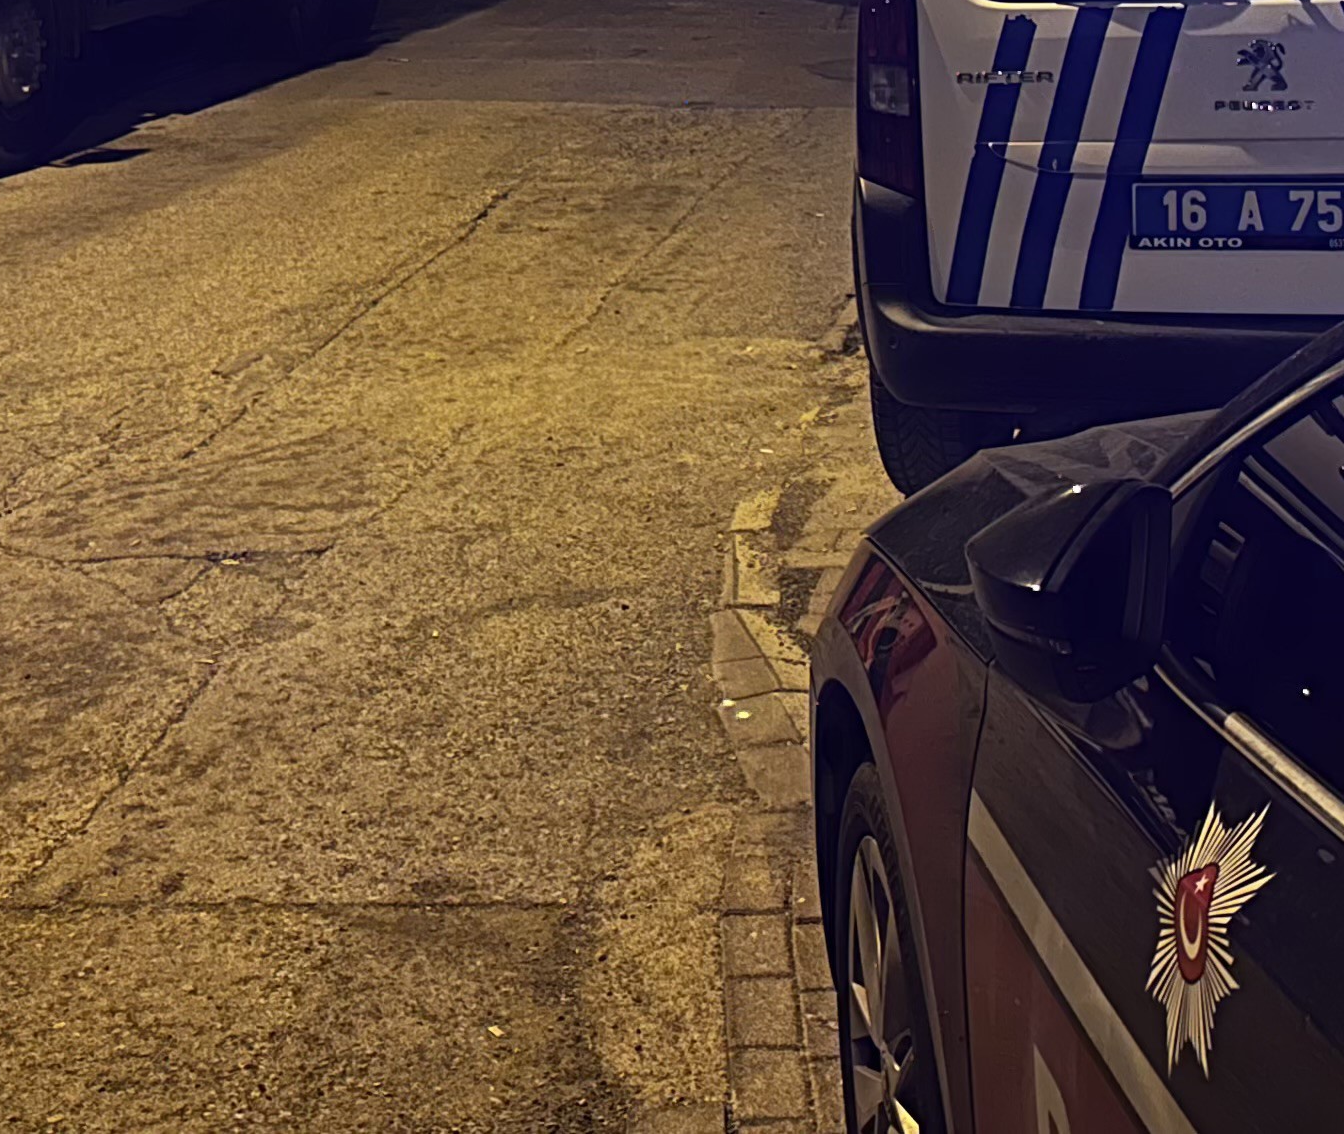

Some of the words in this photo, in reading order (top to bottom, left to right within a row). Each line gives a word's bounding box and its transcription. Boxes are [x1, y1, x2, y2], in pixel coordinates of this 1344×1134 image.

[1214, 100, 1315, 112] PEUGEOT
[1162, 189, 1207, 232] 16
[1237, 190, 1264, 232] A
[1137, 237, 1192, 248] AKIN
[1198, 237, 1243, 248] OTO
